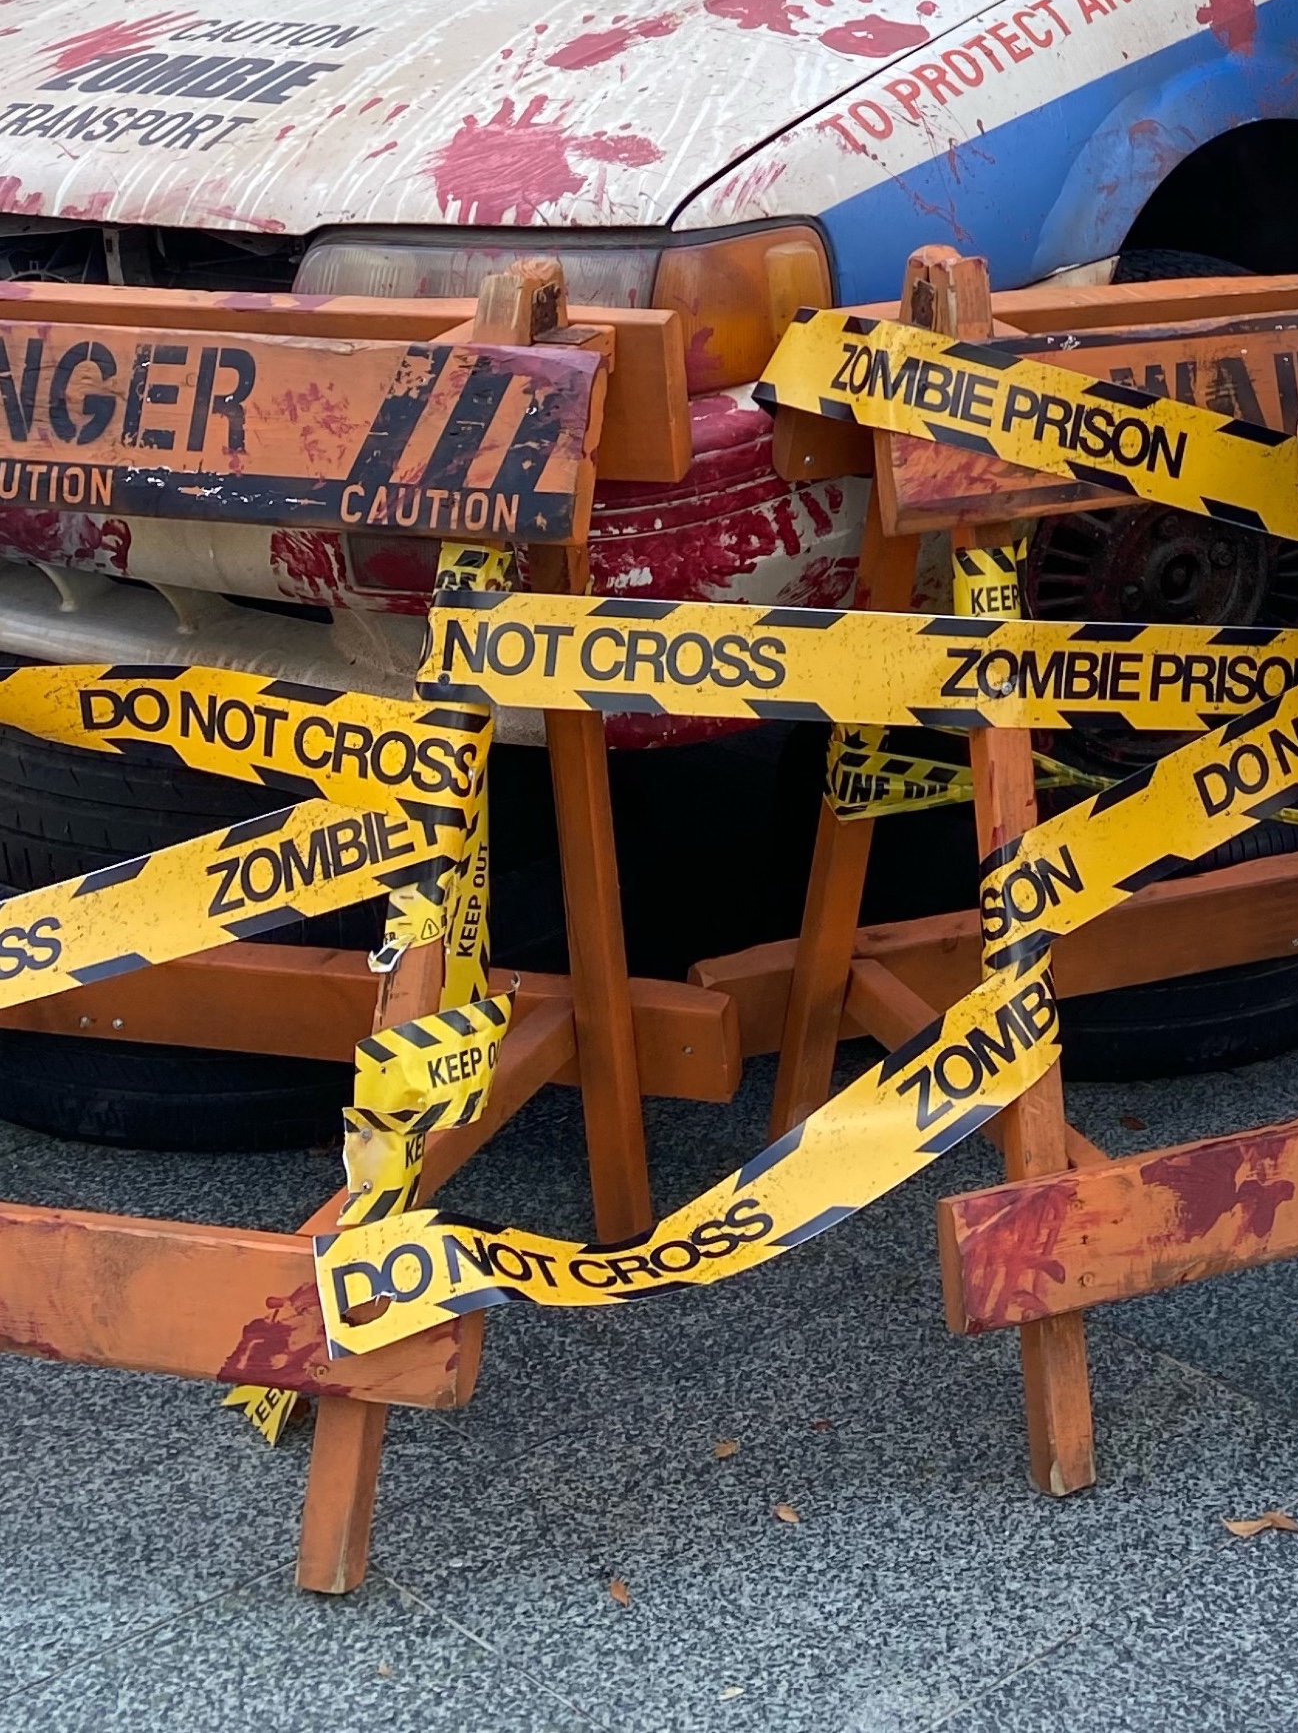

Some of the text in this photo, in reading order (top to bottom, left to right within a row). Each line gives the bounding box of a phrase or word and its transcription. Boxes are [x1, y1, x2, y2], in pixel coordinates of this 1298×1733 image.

[168, 19, 377, 49] CAUTION
[35, 53, 345, 105] ZOMBIE
[0, 102, 260, 152] TRANSPORT
[819, 100, 894, 155] TO
[831, 343, 1000, 428] ZOMBIE
[1001, 384, 1188, 479] PRISON
[340, 484, 519, 533] CAUTION
[441, 619, 575, 678] NOT
[580, 627, 787, 689] CROSS
[941, 647, 1144, 701] ZOMBIE
[79, 687, 477, 798] DO NOT CROSS
[1193, 743, 1270, 819] DO
[206, 811, 416, 918] ZOMBIE
[456, 841, 489, 958] KEEP OUT
[427, 1046, 483, 1089] KEEP
[331, 1198, 774, 1313] DO NOT CROSS
